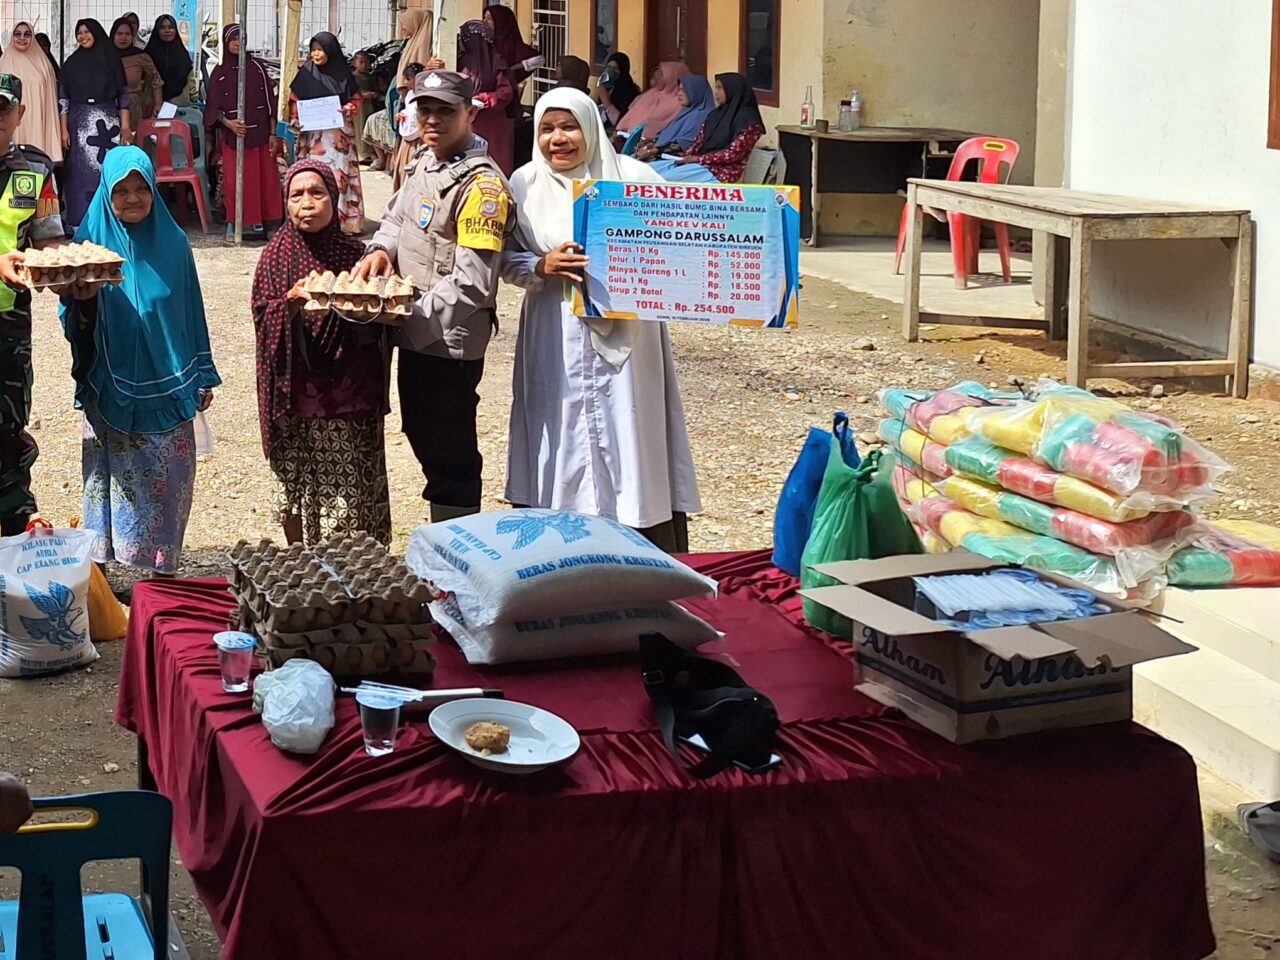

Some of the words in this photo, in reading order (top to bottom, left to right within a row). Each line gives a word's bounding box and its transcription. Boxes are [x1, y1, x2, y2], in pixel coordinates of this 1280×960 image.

[625, 184, 744, 201] PENERIMA
[603, 200, 639, 208] SEMBAKO
[641, 201, 658, 209] DARI
[660, 202, 682, 210] HASIL
[685, 203, 707, 211] BUMG
[709, 204, 727, 212] BINA
[730, 205, 766, 213] BERSAMA
[651, 210, 699, 218] PENDAPATAN
[643, 219, 674, 227] YANG
[676, 220, 689, 228] KE
[606, 228, 672, 240] GAMPONG
[675, 231, 764, 244] DARUSSALAM
[608, 245, 632, 253] Beras
[648, 247, 659, 255] Kg
[707, 250, 722, 258] Rp.
[725, 251, 761, 259] 145.000
[608, 255, 628, 263] Telur
[639, 257, 665, 265] Papan
[707, 260, 722, 268] Rp.
[730, 261, 761, 270] 52.000
[608, 265, 638, 274] Minyak
[641, 267, 671, 277] Goreng
[707, 271, 722, 279] Rp.
[731, 272, 761, 280] 19.000
[637, 277, 648, 285] Kg
[707, 281, 722, 289] Rp.
[731, 282, 761, 291] 18.500
[608, 286, 630, 294] Sirup
[641, 287, 663, 296] Botol
[707, 291, 722, 299] Rp.
[730, 292, 761, 301] 20.000
[635, 300, 665, 310] TOTAL
[674, 302, 691, 313] Rp.
[694, 303, 735, 314] 254.500
[16, 563, 32, 575] CAP
[34, 558, 60, 570] ELANG
[516, 560, 556, 580] BERAS
[558, 553, 621, 569] JONGKONG
[515, 619, 555, 633] BERAS
[861, 626, 947, 685] Alham
